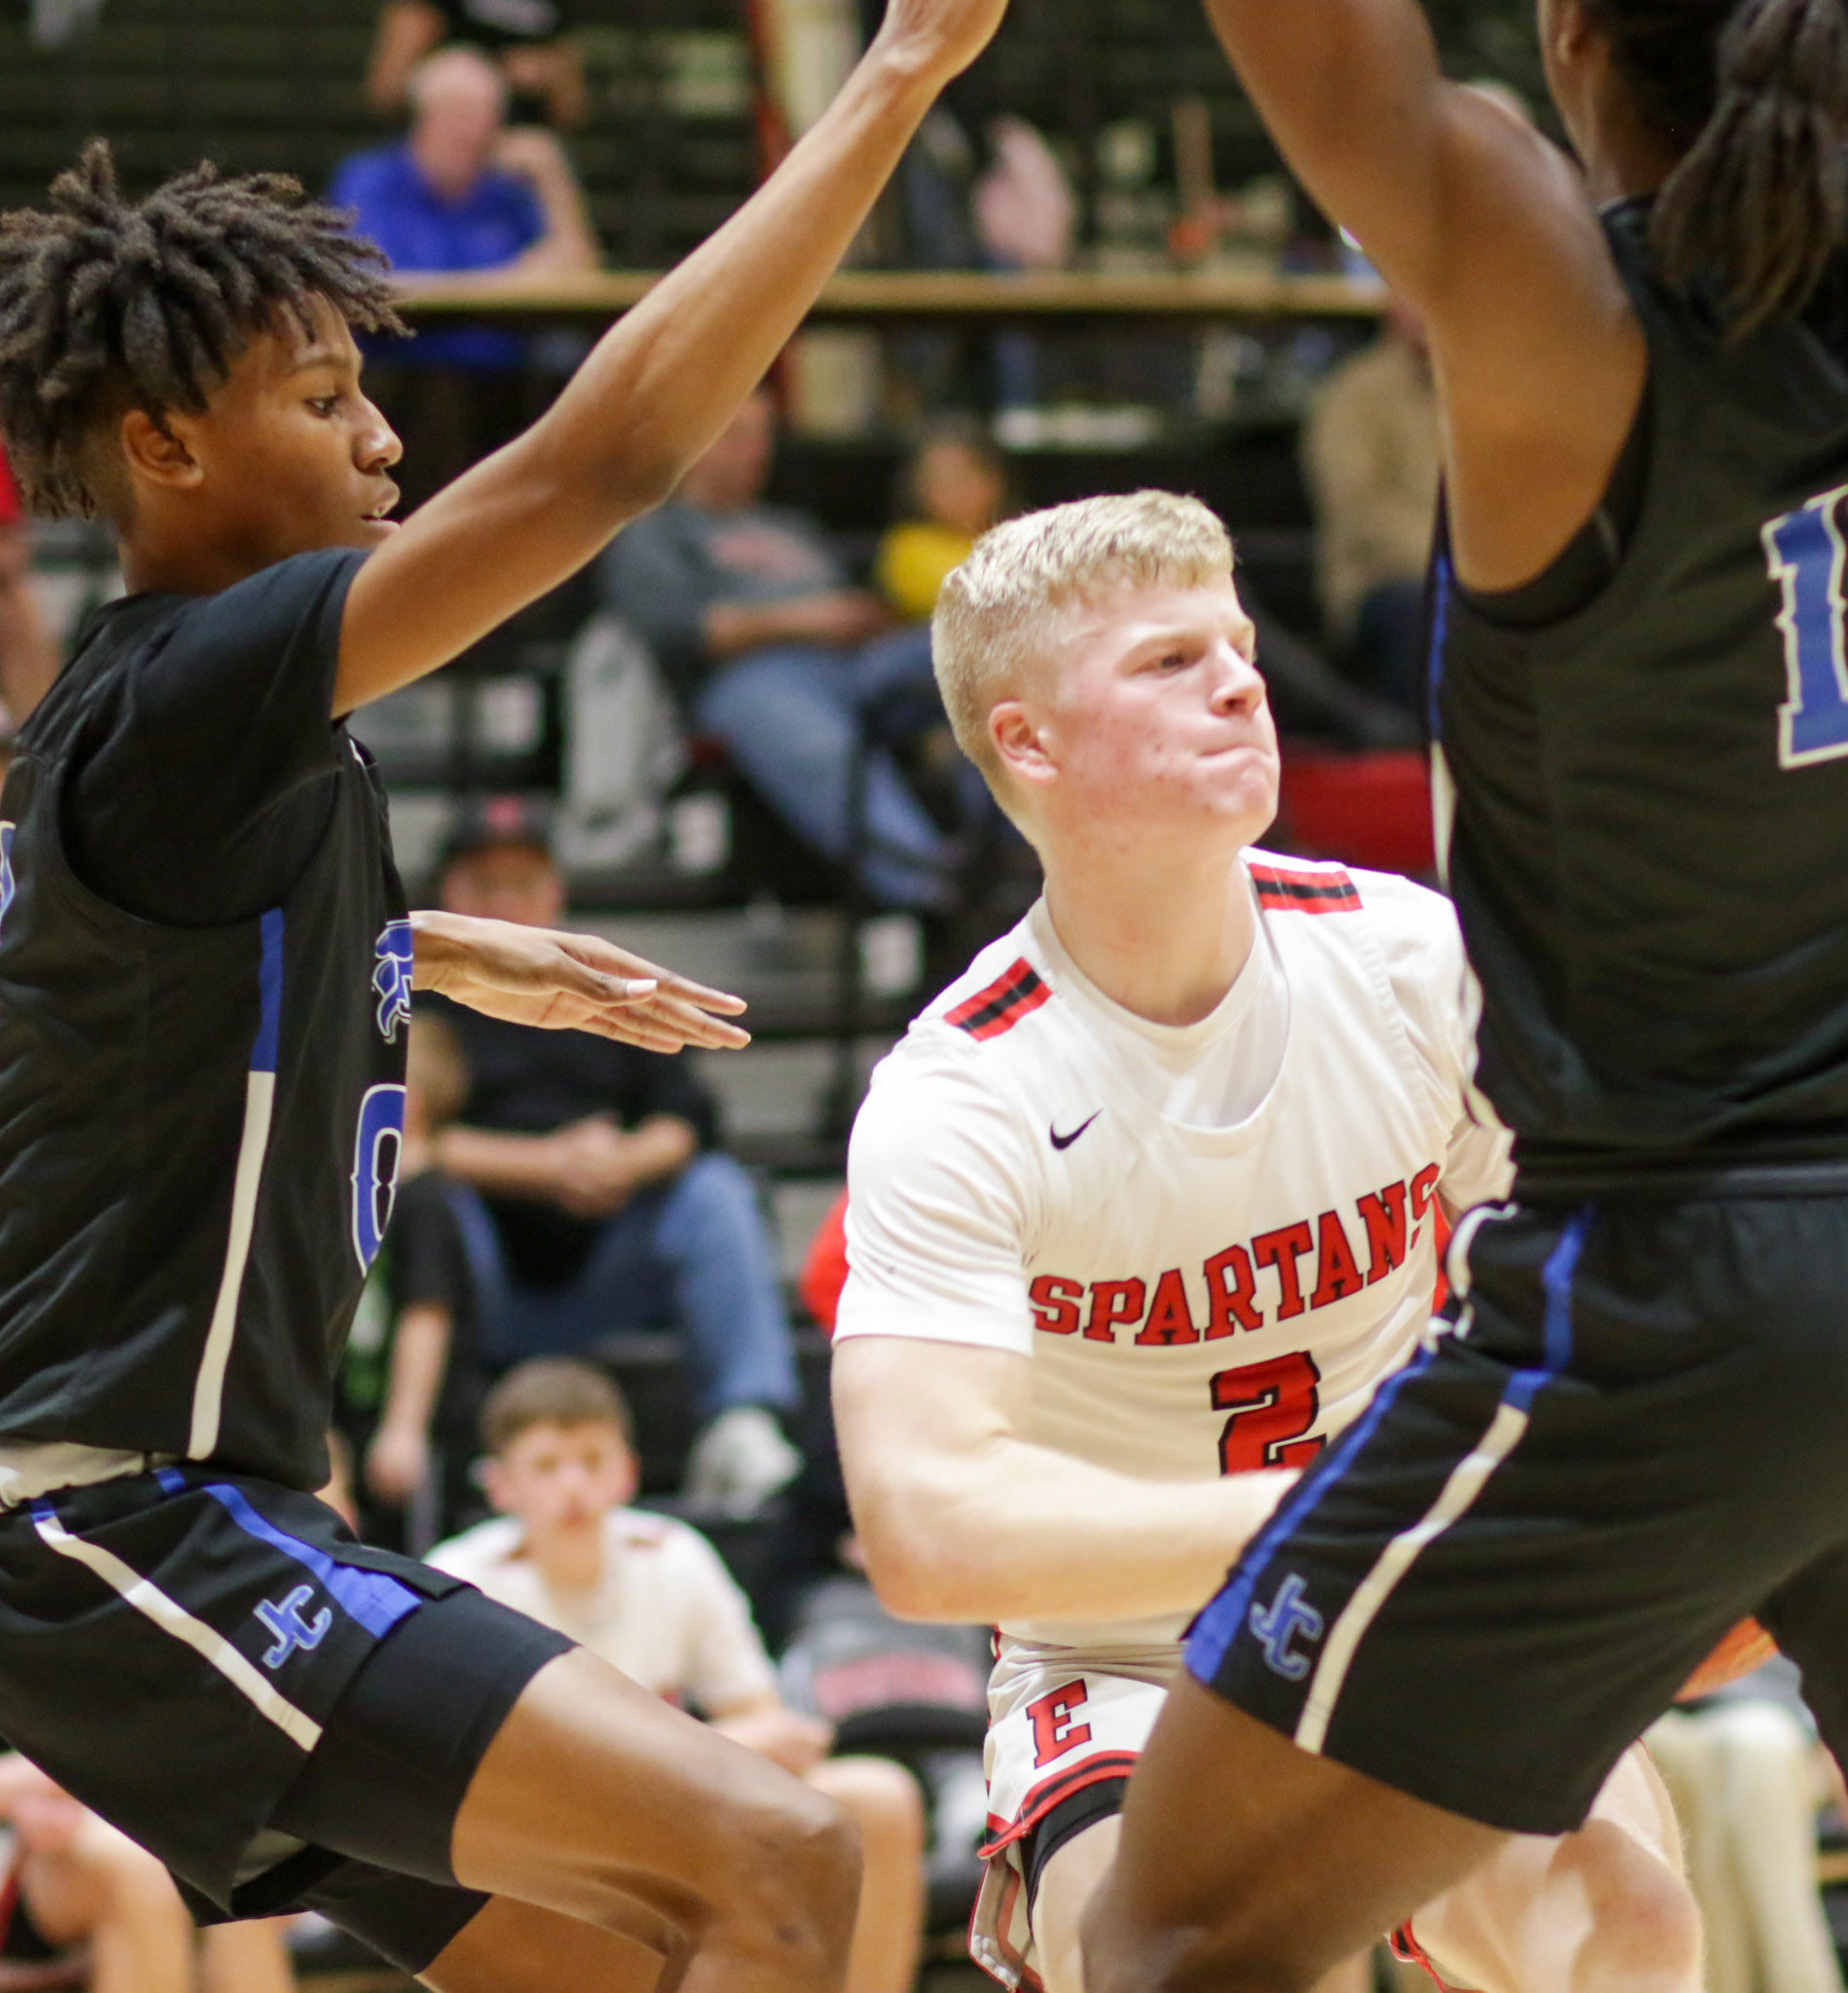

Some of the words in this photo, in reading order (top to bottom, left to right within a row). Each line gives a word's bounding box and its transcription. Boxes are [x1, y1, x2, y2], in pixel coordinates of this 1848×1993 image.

[1209, 1350, 1326, 1478] 2
[252, 1584, 333, 1670] JC
[1026, 1678, 1092, 1769] E
